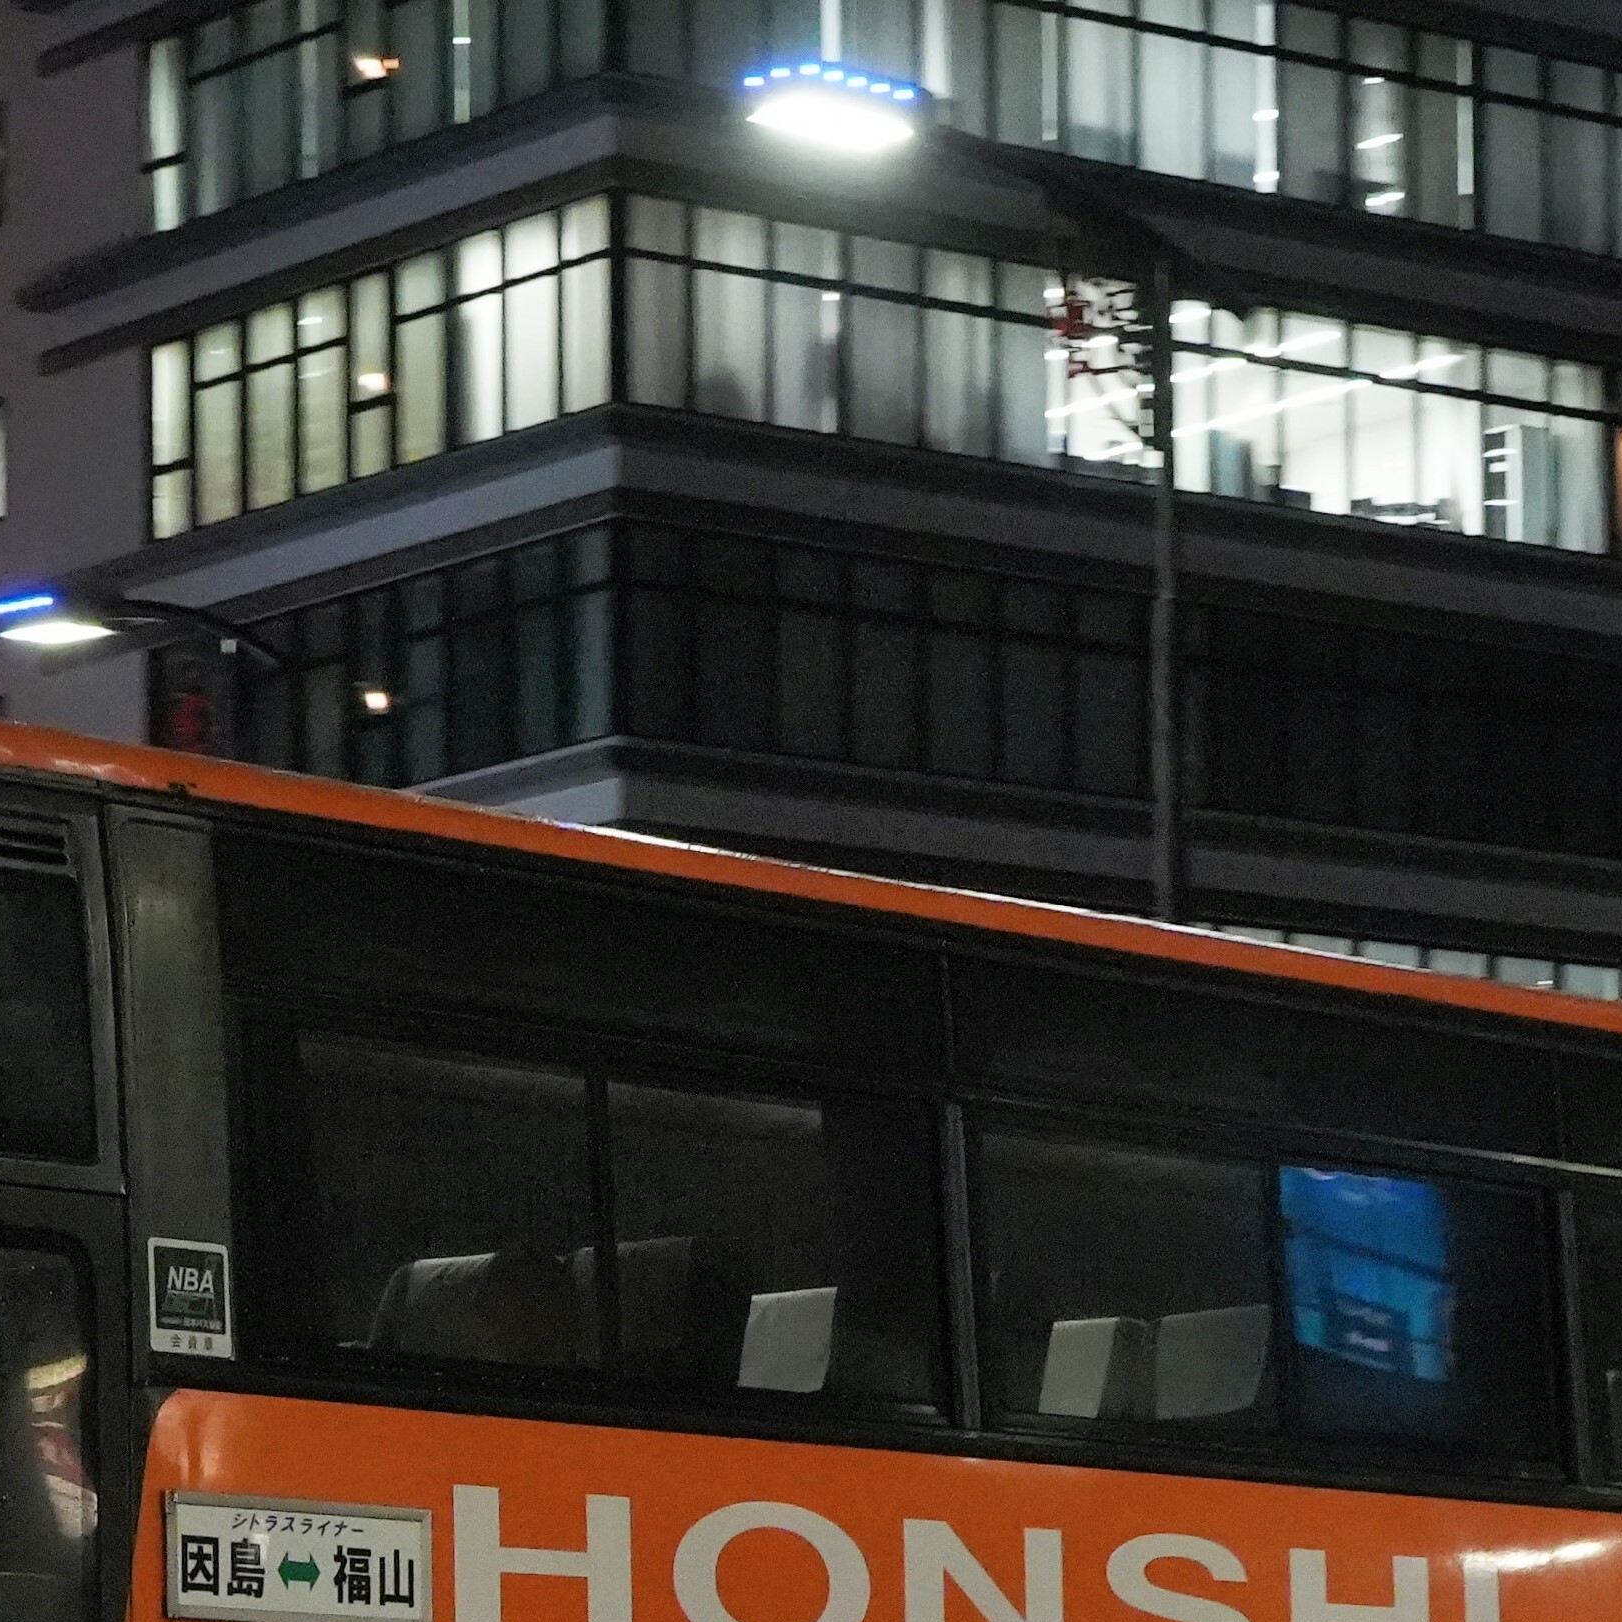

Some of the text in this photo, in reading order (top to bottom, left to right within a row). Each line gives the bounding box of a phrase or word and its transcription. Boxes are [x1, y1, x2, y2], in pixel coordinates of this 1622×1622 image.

[167, 1266, 215, 1293] NBA
[231, 1513, 365, 1537] シトラスライナー
[180, 1533, 415, 1609] 因島 福山
